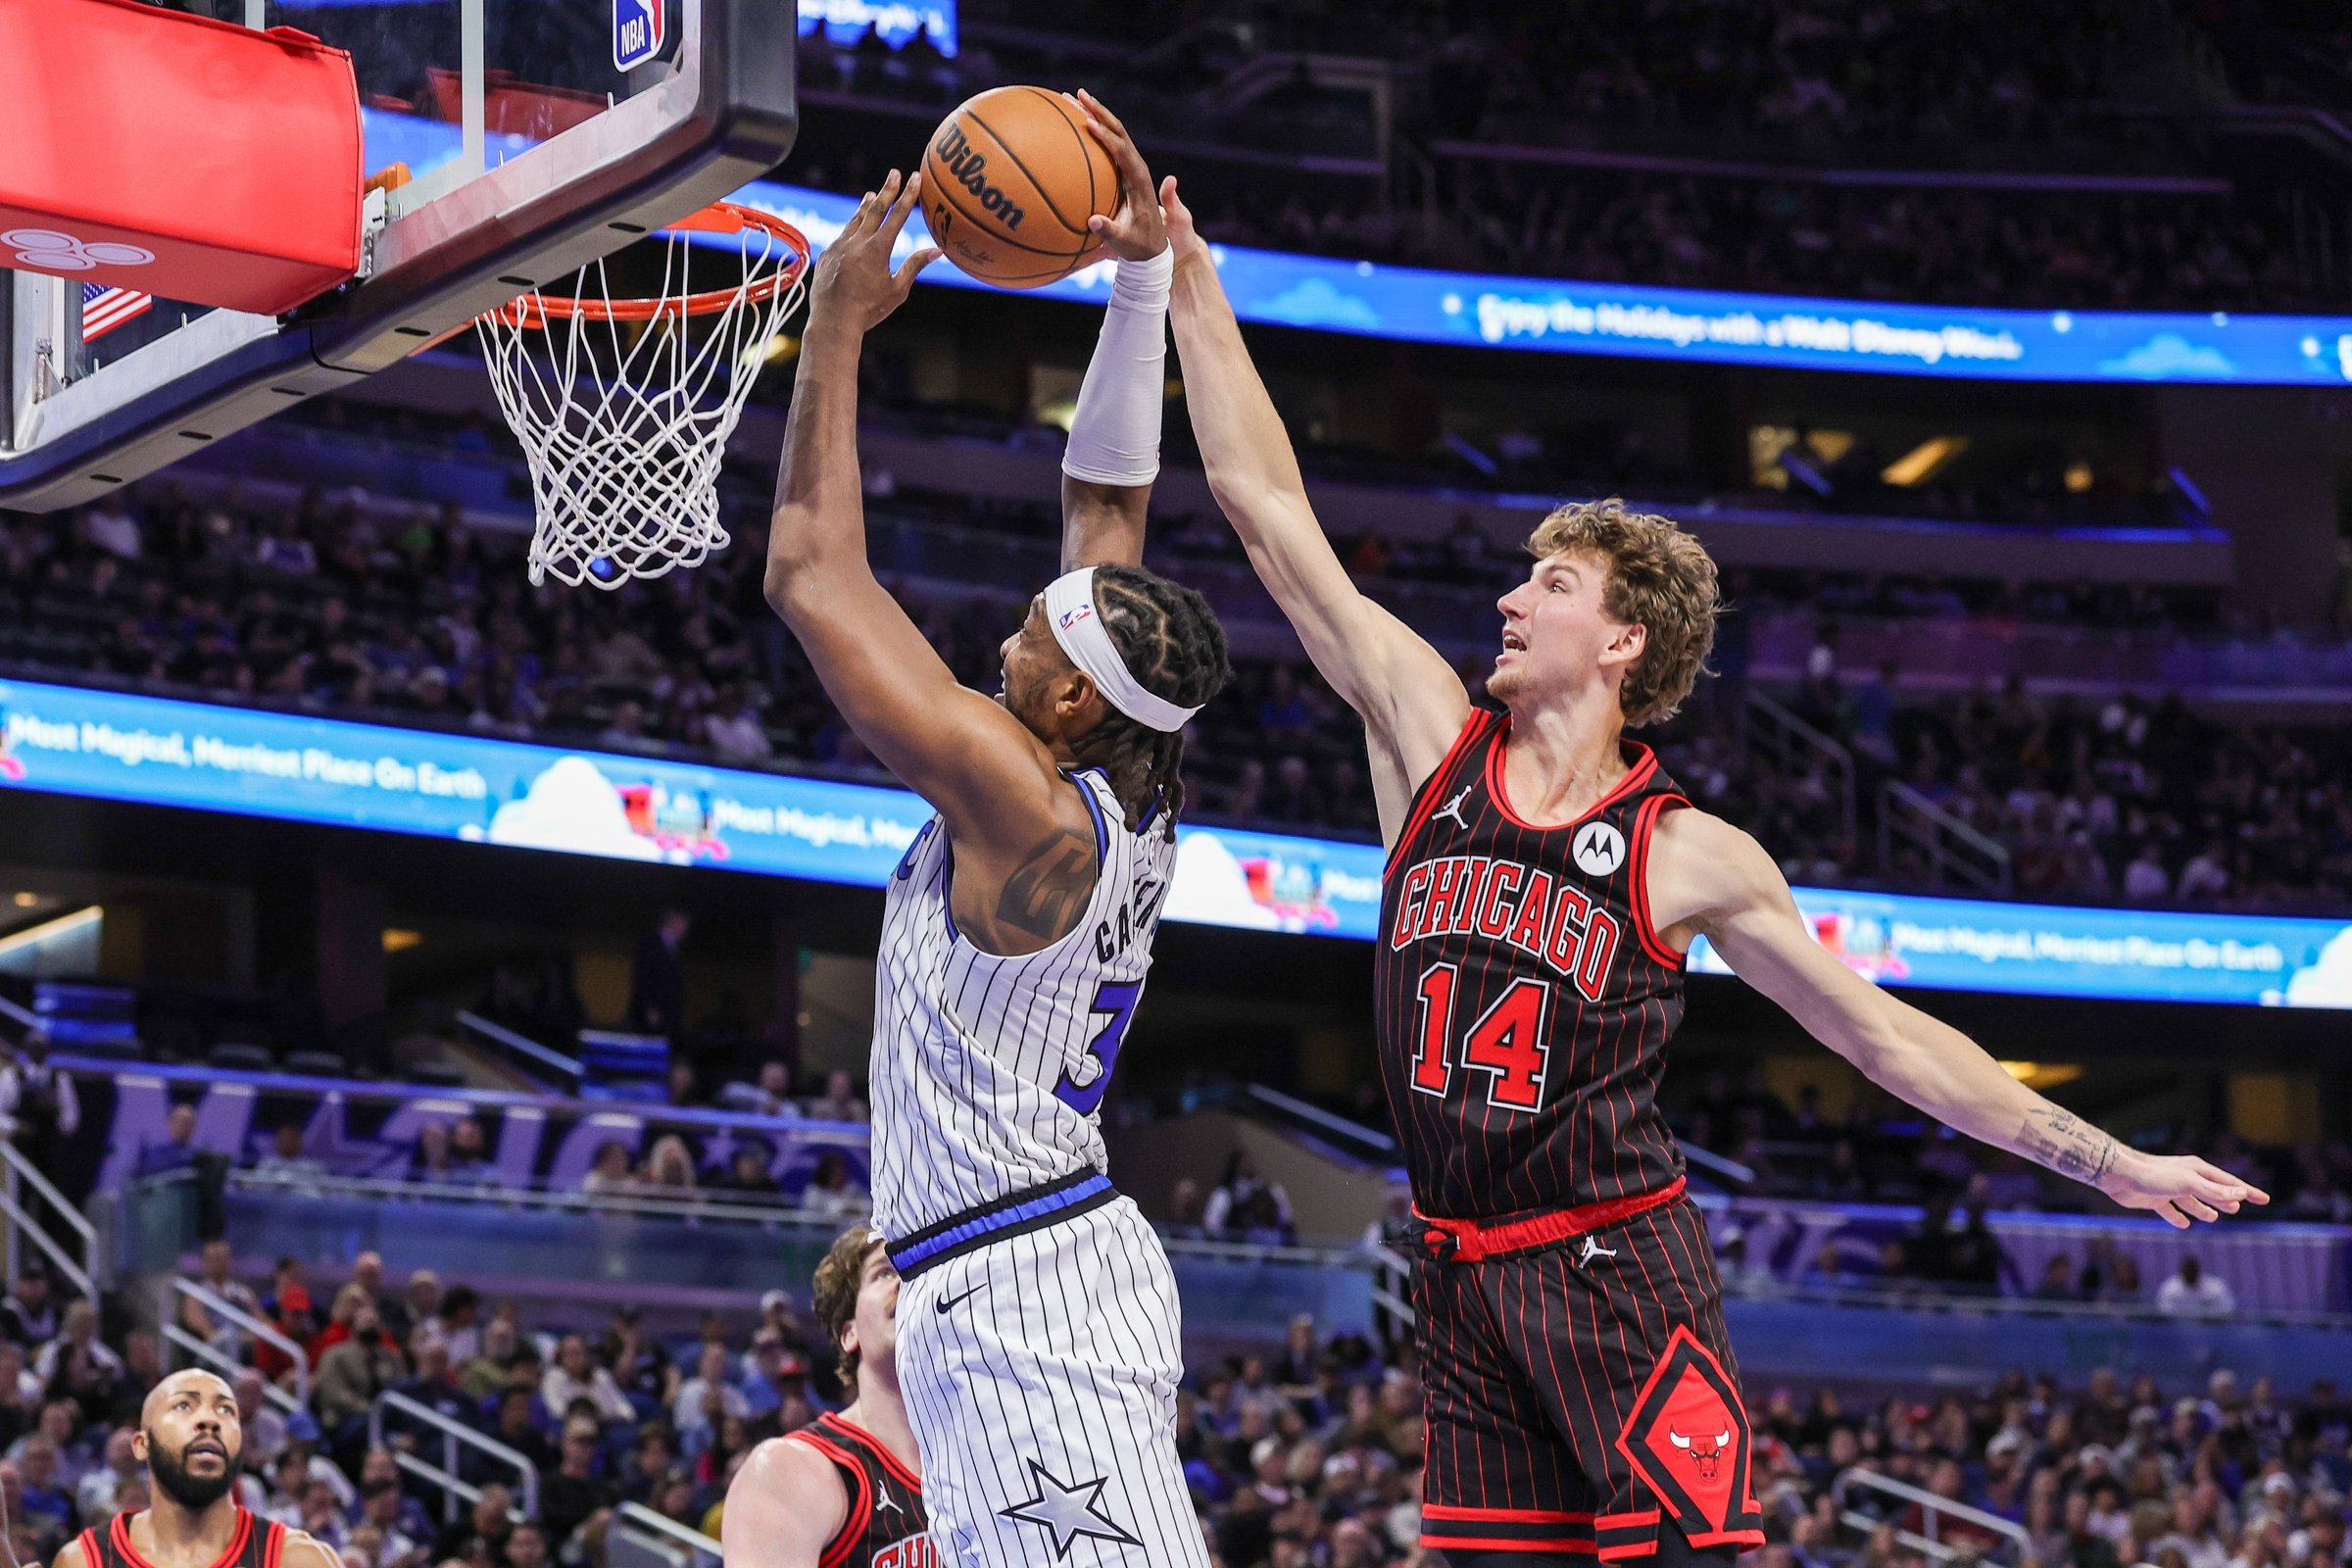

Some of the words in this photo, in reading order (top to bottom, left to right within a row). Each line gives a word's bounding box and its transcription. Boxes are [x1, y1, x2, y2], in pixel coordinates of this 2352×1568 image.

[621, 15, 646, 58] NBA
[936, 122, 1025, 231] Wilson
[302, 747, 373, 787] Place
[374, 758, 416, 792] On
[417, 761, 486, 800] Earth
[1391, 856, 1620, 1003] CHICAGO
[1053, 977, 1144, 1117] 3
[1411, 960, 1549, 1113] 14
